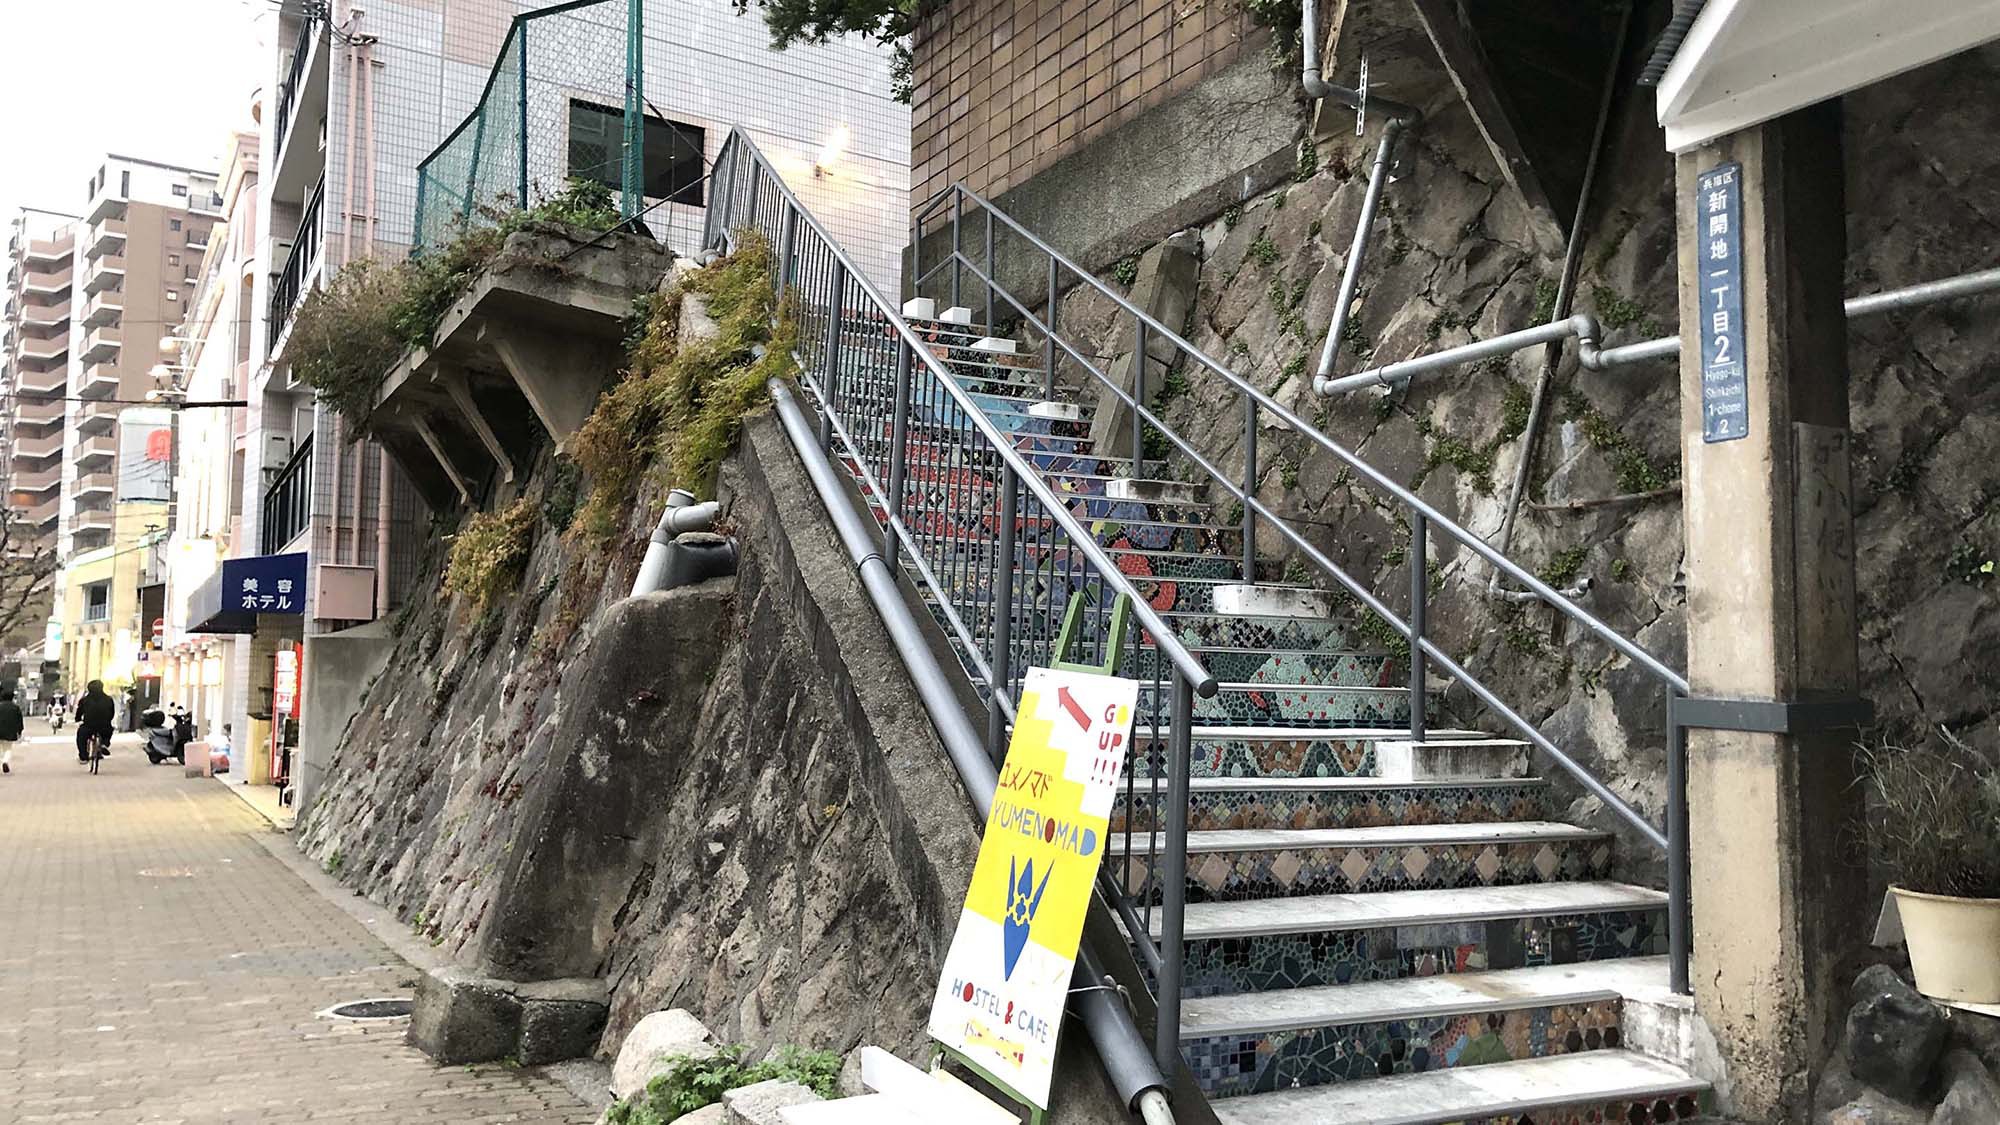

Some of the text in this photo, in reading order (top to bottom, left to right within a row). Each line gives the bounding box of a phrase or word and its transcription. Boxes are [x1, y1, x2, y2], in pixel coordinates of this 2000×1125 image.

[1703, 172, 1733, 190] 兵庫区
[1708, 402, 1741, 416] 1-chome
[1720, 419, 1729, 434] 2
[241, 594, 291, 610] ホテル
[1104, 704, 1129, 726] GO
[1000, 762, 1053, 799] ユメノマド
[993, 800, 1096, 856] YUMENOMAD
[952, 978, 1000, 1016] HOSTEL
[1004, 1001, 1013, 1025] &
[1017, 1009, 1048, 1044] CAFE
